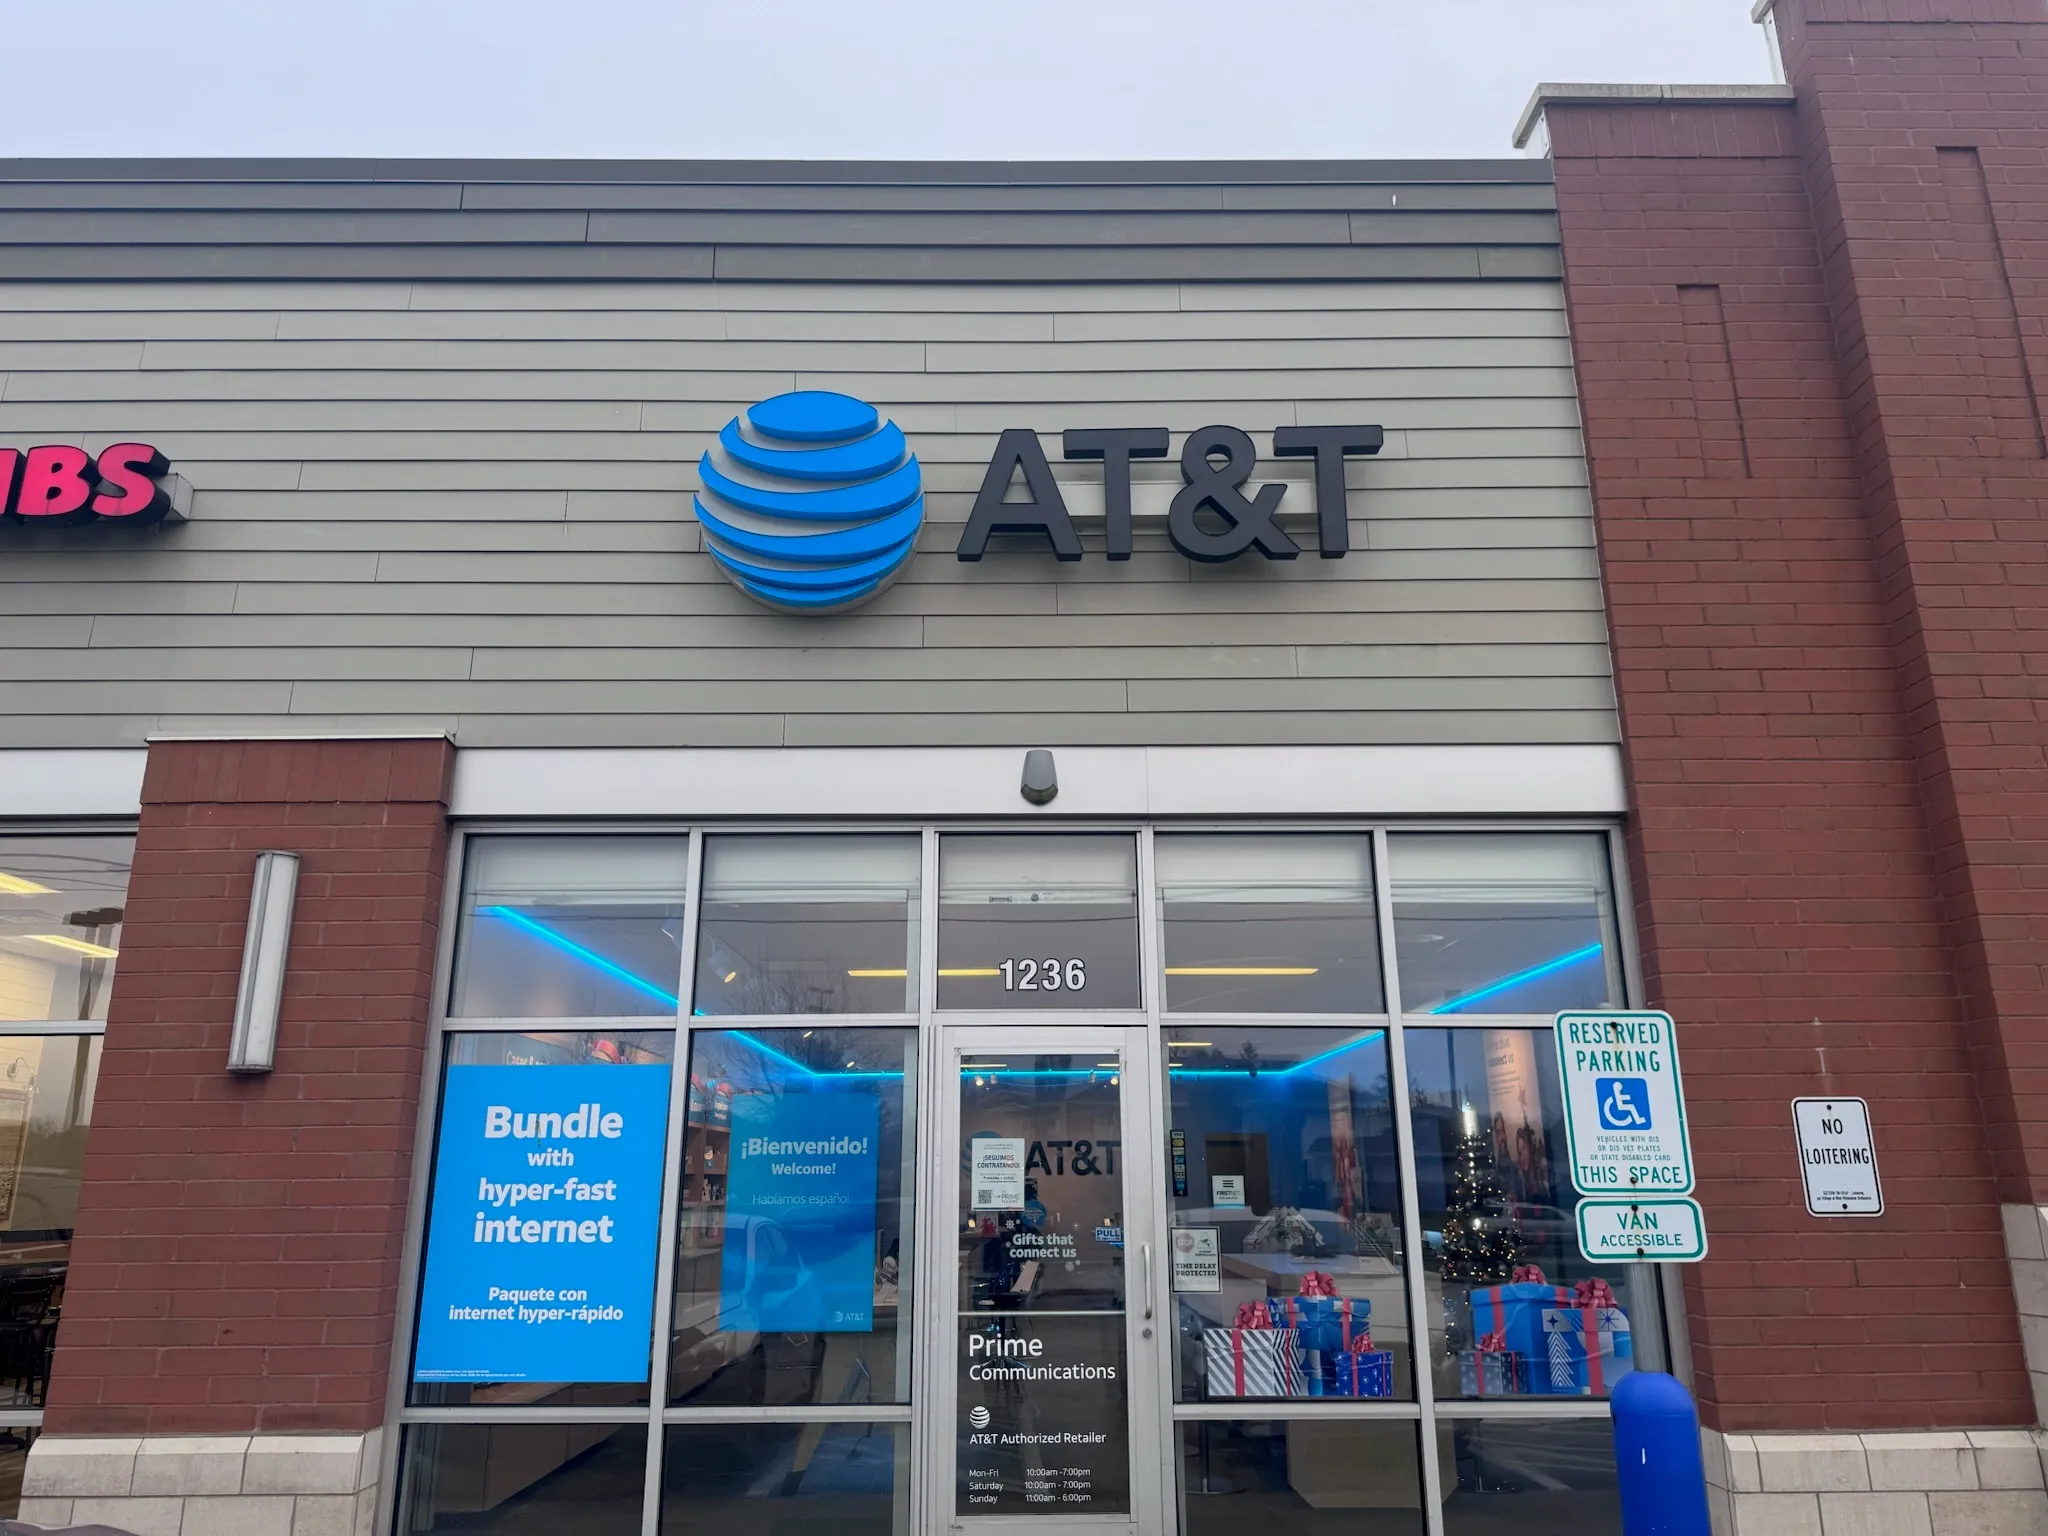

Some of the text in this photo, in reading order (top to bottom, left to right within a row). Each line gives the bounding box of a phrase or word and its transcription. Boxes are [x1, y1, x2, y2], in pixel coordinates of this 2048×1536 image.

[956, 424, 1383, 562] AT&T
[1000, 958, 1086, 991] 1236
[1568, 1022, 1661, 1044] RESERVED
[1576, 1050, 1661, 1073] PARKING
[484, 1103, 624, 1139] Bundle
[1822, 1118, 1843, 1135] NO
[741, 1136, 868, 1160] ¡Bienvenido!
[1596, 1135, 1660, 1143] VEHICLES WITH DIS
[1637, 1144, 1661, 1152] PLATES
[527, 1148, 575, 1167] with
[1025, 1139, 1121, 1176] AT&T
[1805, 1148, 1870, 1165] LOITERING
[771, 1162, 837, 1175] Welcome!
[1579, 1166, 1683, 1184] THIS SPACE
[478, 1177, 617, 1207] hyper-fast
[752, 1193, 806, 1205] Hablamos
[474, 1211, 614, 1243] internet
[1616, 1212, 1658, 1230] VAN
[1012, 1233, 1074, 1245] Gifts that
[1600, 1233, 1683, 1247] ACCESSIBLE
[1009, 1247, 1077, 1258] connect us
[488, 1286, 588, 1305] Paquete con
[449, 1304, 624, 1325] internet hyper-rápido
[844, 1312, 865, 1321] AT&T
[969, 1332, 1043, 1357] Prime
[969, 1363, 1116, 1381] Communications
[969, 1431, 1107, 1444] AT&T Authorized Retailer
[969, 1468, 999, 1477] Mon-Fri
[1026, 1468, 1058, 1476] 10:00am
[969, 1481, 1004, 1492] Saturday
[1024, 1481, 1057, 1489] 10:00am
[1063, 1480, 1091, 1490] 7:00pm
[969, 1494, 998, 1505] Sunday
[1025, 1494, 1056, 1502] 11:00am
[1062, 1493, 1092, 1503] 6:00pm
